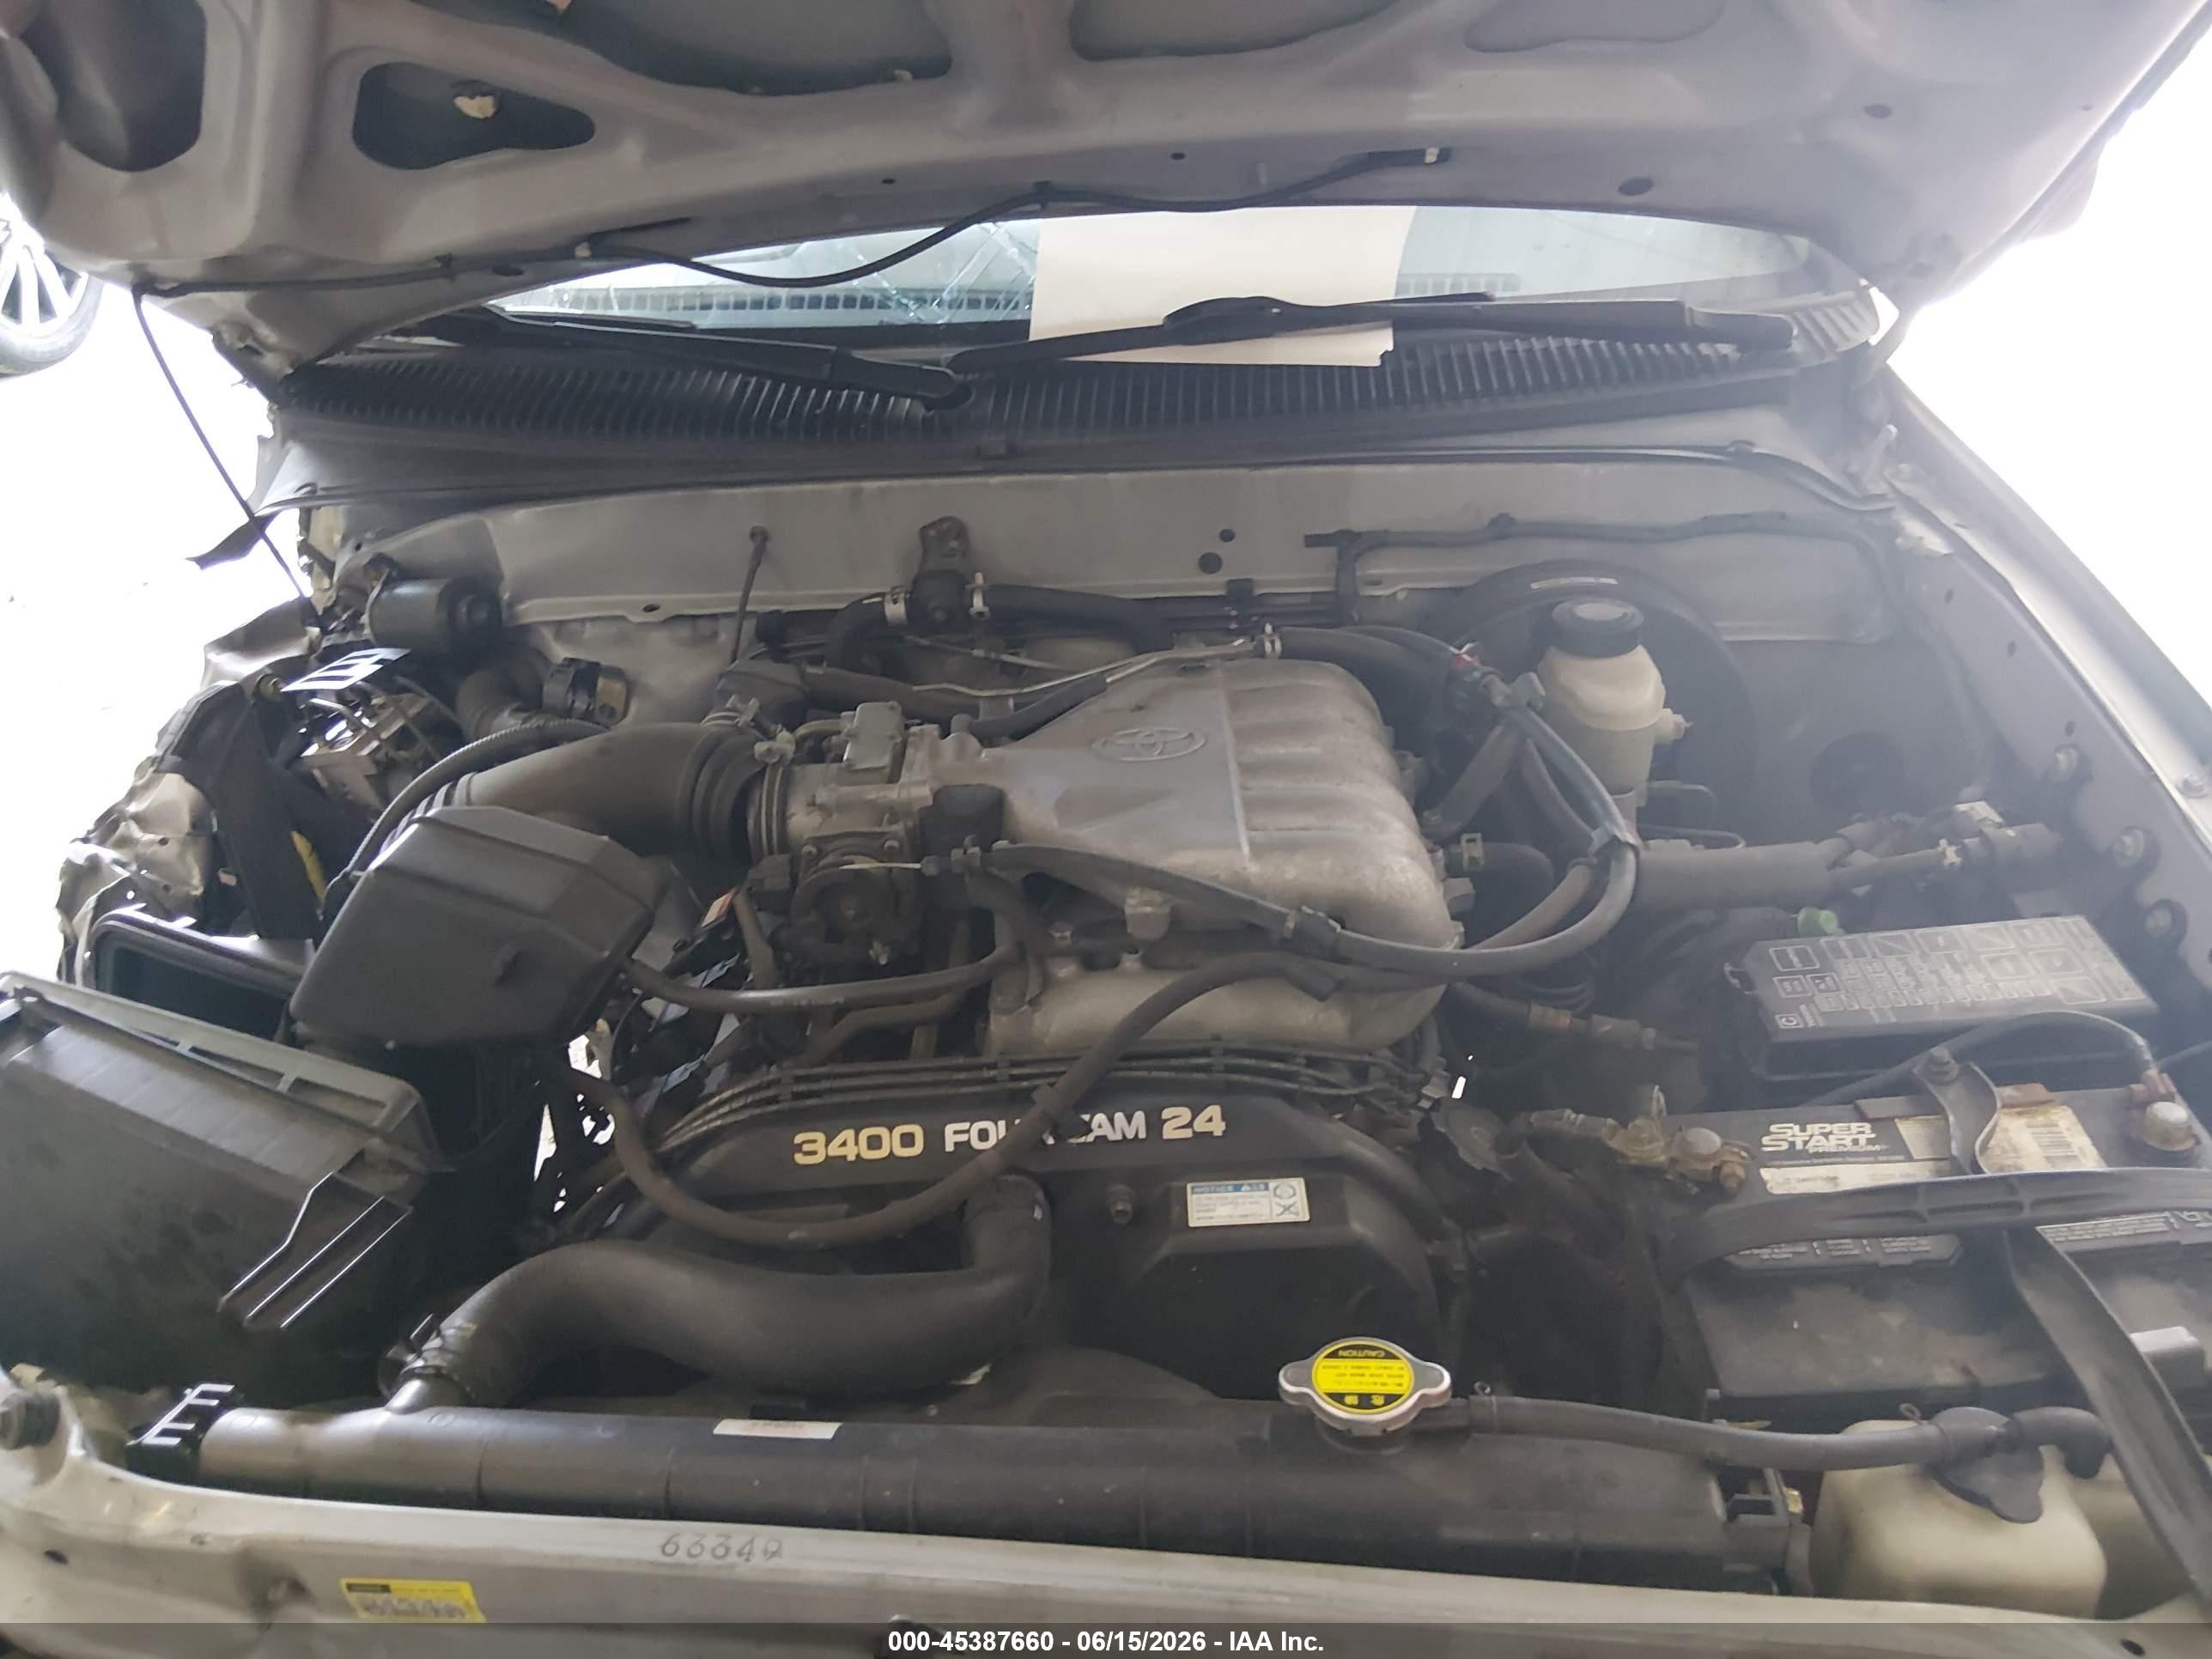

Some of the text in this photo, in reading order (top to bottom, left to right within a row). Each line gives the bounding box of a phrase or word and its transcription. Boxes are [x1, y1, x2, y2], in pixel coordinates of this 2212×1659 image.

[793, 1124, 925, 1165] 3400
[1161, 1104, 1226, 1140] 24
[1769, 1121, 1873, 1136] SUPER
[1761, 1133, 1877, 1152] START
[1338, 1349, 1386, 1358] CAUTION
